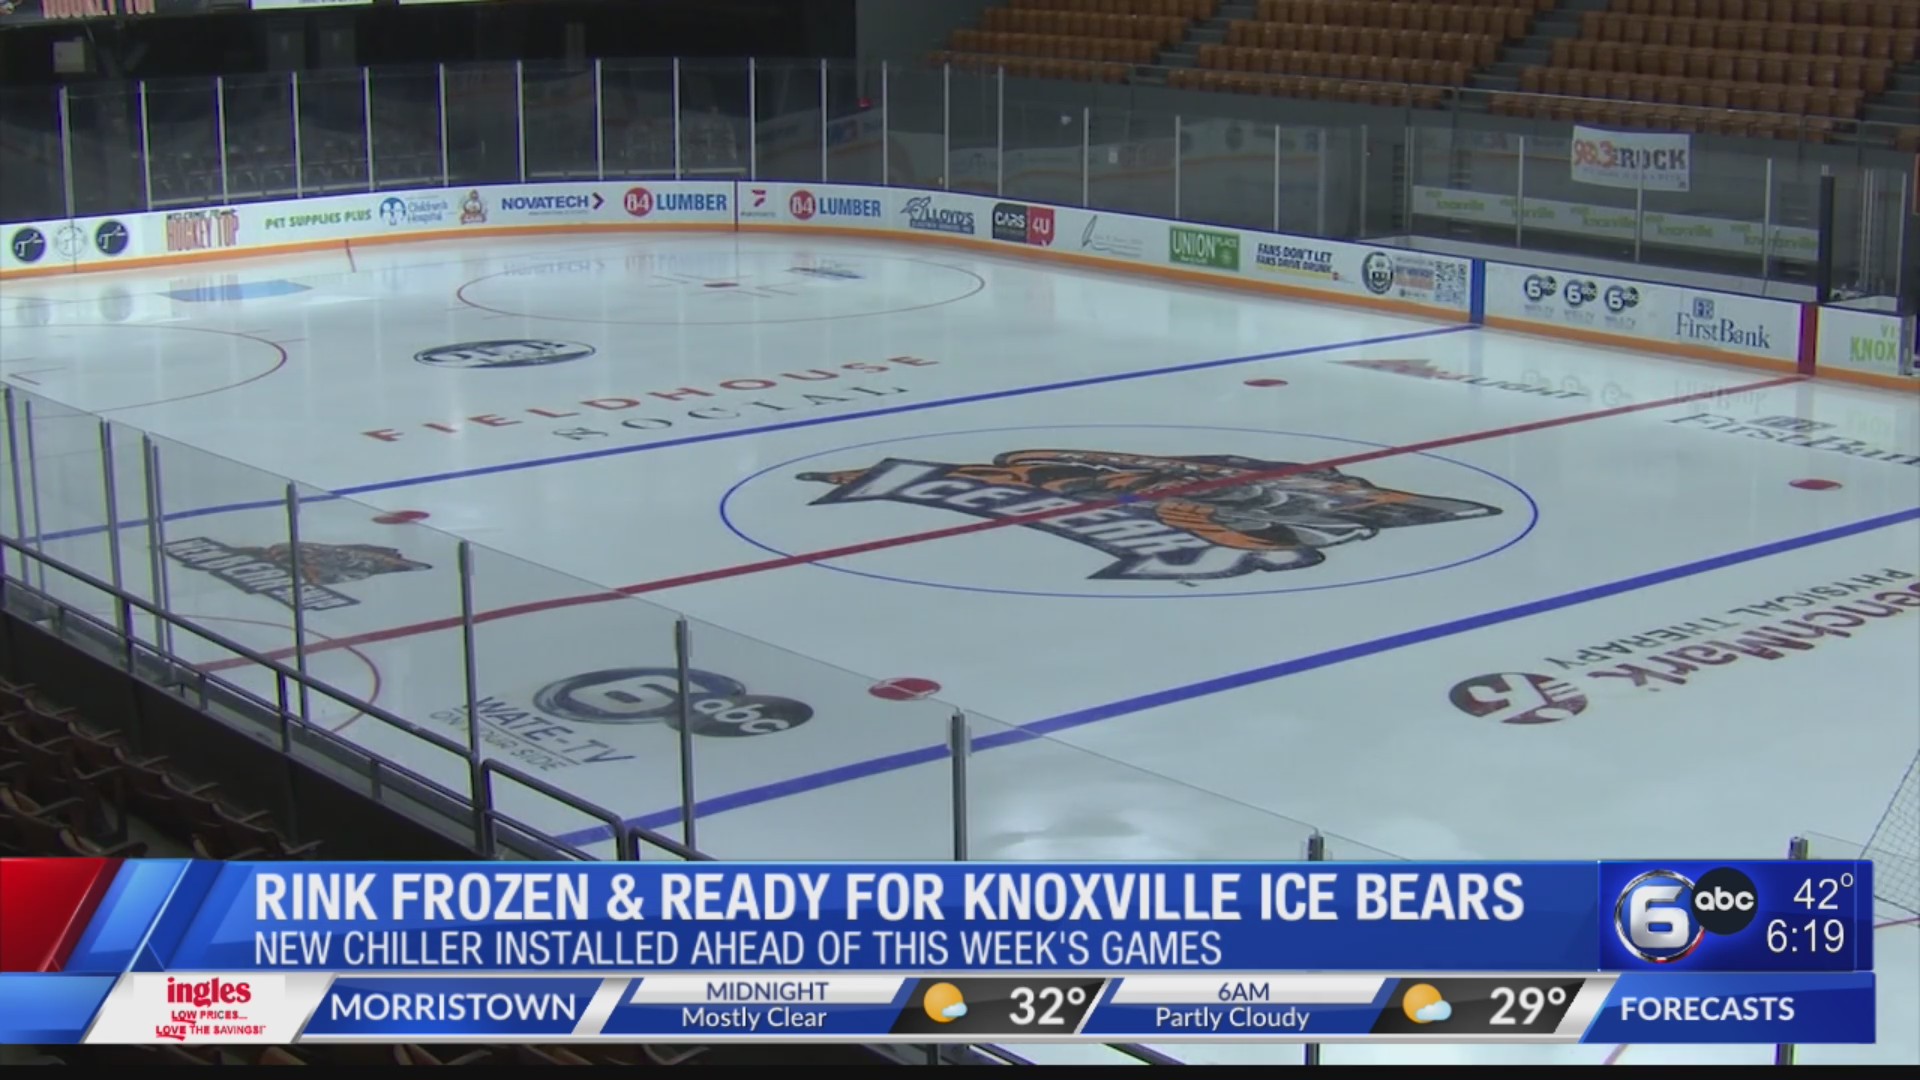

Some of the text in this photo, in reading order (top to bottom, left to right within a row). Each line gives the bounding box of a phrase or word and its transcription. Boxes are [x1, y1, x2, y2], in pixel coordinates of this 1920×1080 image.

[502, 194, 588, 210] NOVATECH
[626, 192, 727, 212] 84 LUMBER
[792, 194, 881, 217] 84 LUMBER
[289, 212, 341, 228] SUPPLIES
[344, 208, 372, 222] PLUS
[994, 211, 1025, 229] CARS
[1032, 217, 1051, 234] 4U
[1173, 229, 1216, 259] UNION
[1314, 250, 1333, 263] LET
[1676, 311, 1770, 349] FirstBank
[1850, 336, 1897, 362] KNOX
[362, 355, 940, 443] FIELDHOUSE
[552, 382, 909, 442] SOCIAL
[1666, 411, 1920, 467] FirstBan
[1545, 568, 1914, 671] PHYSICAL THERAPY
[1588, 583, 1920, 687] enchMark
[693, 697, 790, 734] abc
[510, 748, 567, 771] SIDE
